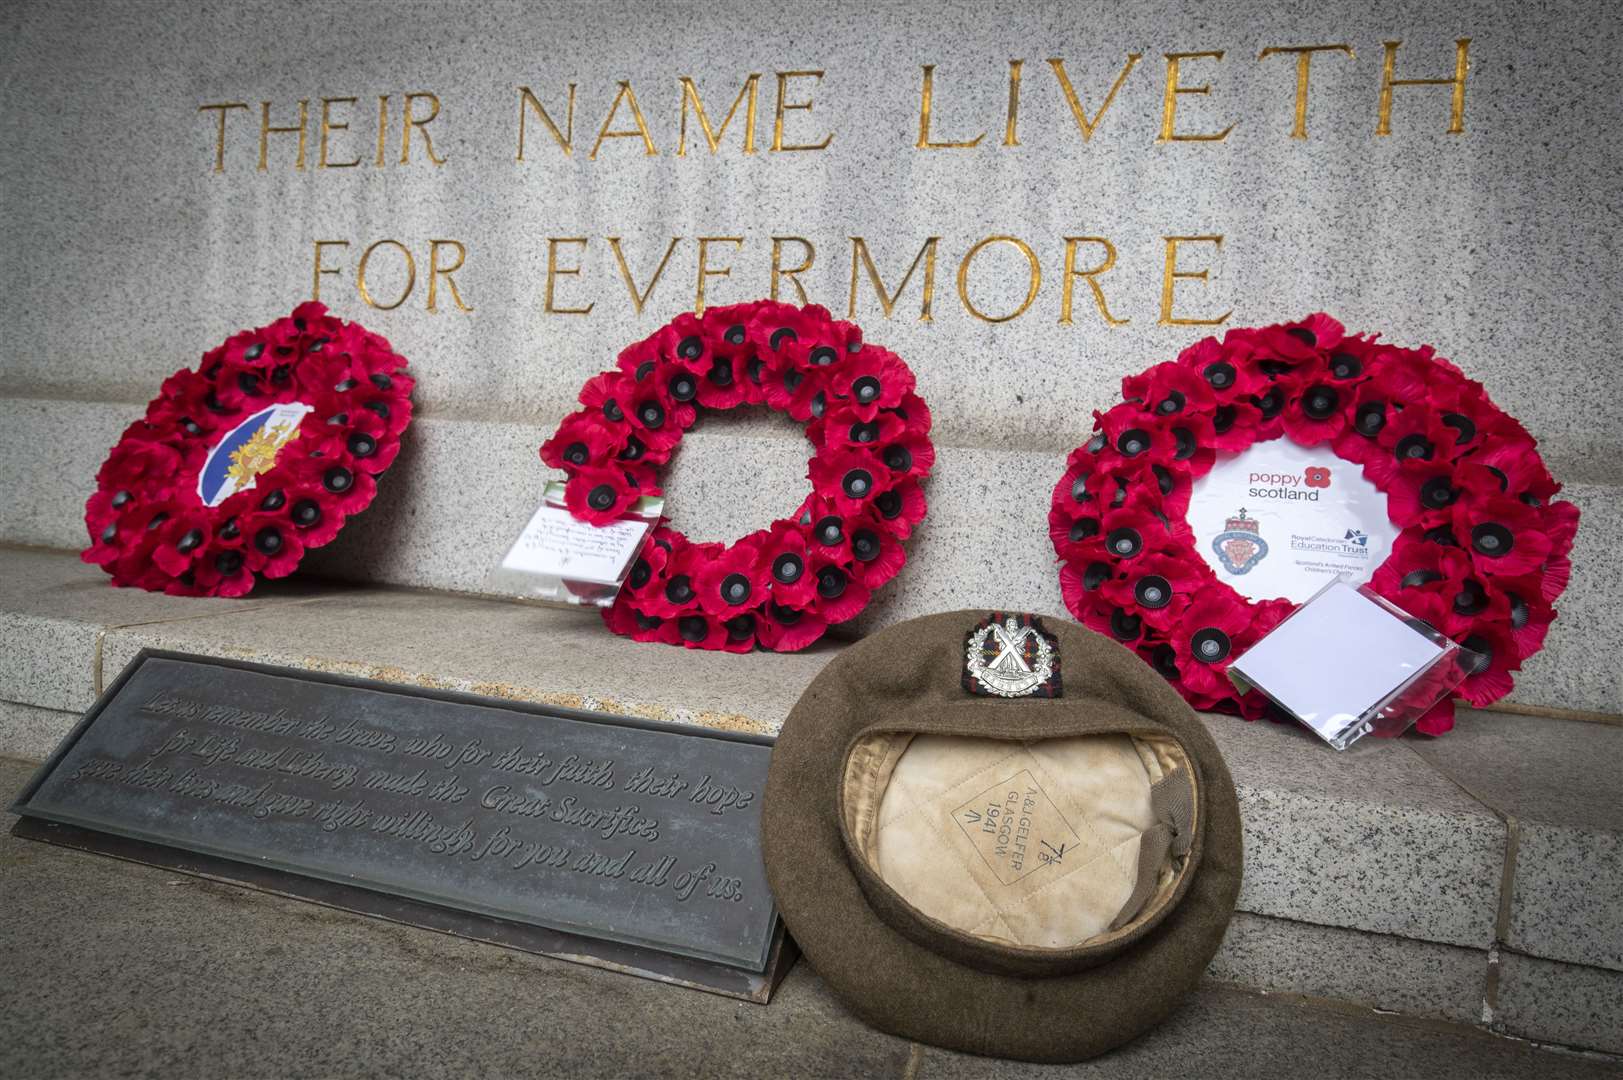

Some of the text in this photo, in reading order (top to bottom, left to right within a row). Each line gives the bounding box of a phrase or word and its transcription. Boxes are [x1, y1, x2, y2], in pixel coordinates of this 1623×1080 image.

[199, 37, 1473, 173] THEIR NAME LIVETH
[313, 234, 1234, 327] FOR EVERMORE
[1249, 472, 1301, 487] poppy
[1249, 487, 1319, 501] scotland
[1291, 540, 1368, 554] Education Trust
[140, 692, 754, 816] Let us remember the brave, who for their faith, their hope
[151, 728, 195, 758] for
[192, 735, 241, 768] Life
[234, 746, 290, 771] and
[362, 767, 430, 797] made
[428, 775, 470, 805] the
[480, 784, 551, 819] Great
[550, 795, 660, 842] Sacrifice,
[120, 760, 173, 788] their
[169, 767, 220, 799] lives
[214, 781, 272, 808] and
[254, 793, 314, 819] gave
[312, 798, 374, 832] right
[471, 826, 525, 860] for
[512, 840, 568, 870] you
[571, 849, 636, 879] and
[628, 855, 678, 887] all
[672, 862, 716, 901] of
[705, 875, 744, 902] us.
[982, 802, 1002, 834] 1941
[994, 790, 1019, 857] GLASGOW
